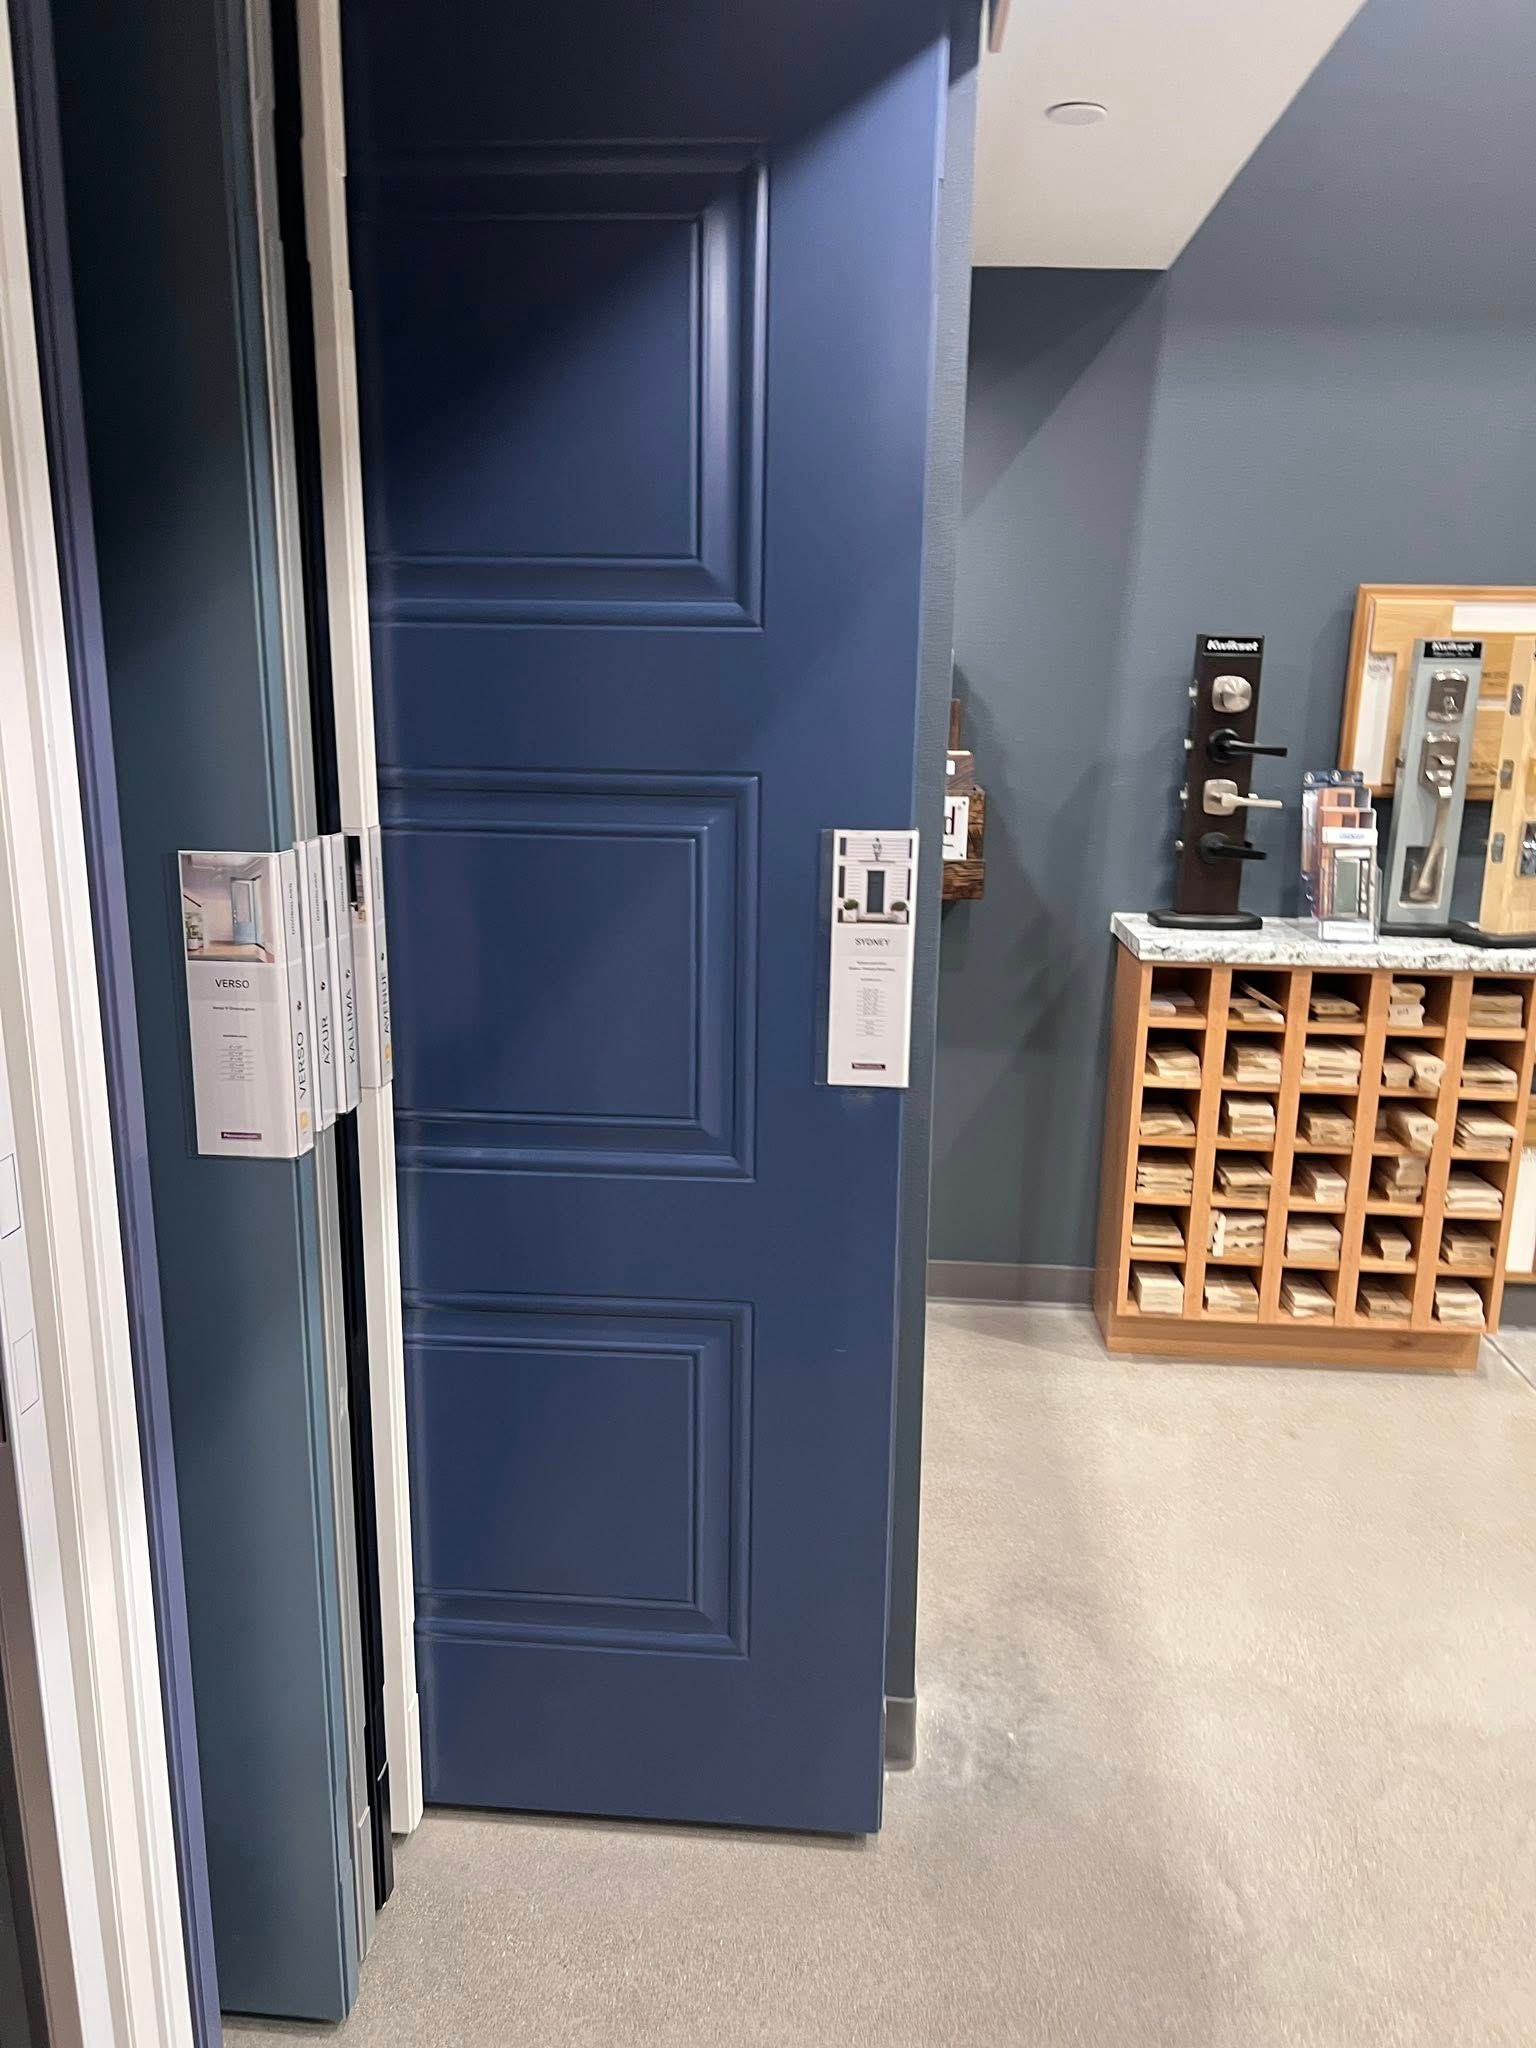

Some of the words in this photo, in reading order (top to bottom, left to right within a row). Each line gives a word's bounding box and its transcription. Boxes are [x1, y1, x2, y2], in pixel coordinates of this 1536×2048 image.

[854, 937, 890, 947] SYDNEY
[214, 978, 250, 989] VERSO
[322, 1015, 331, 1065] AZUR
[345, 987, 356, 1065] KALLIMA
[296, 1031, 307, 1100] VERSO
